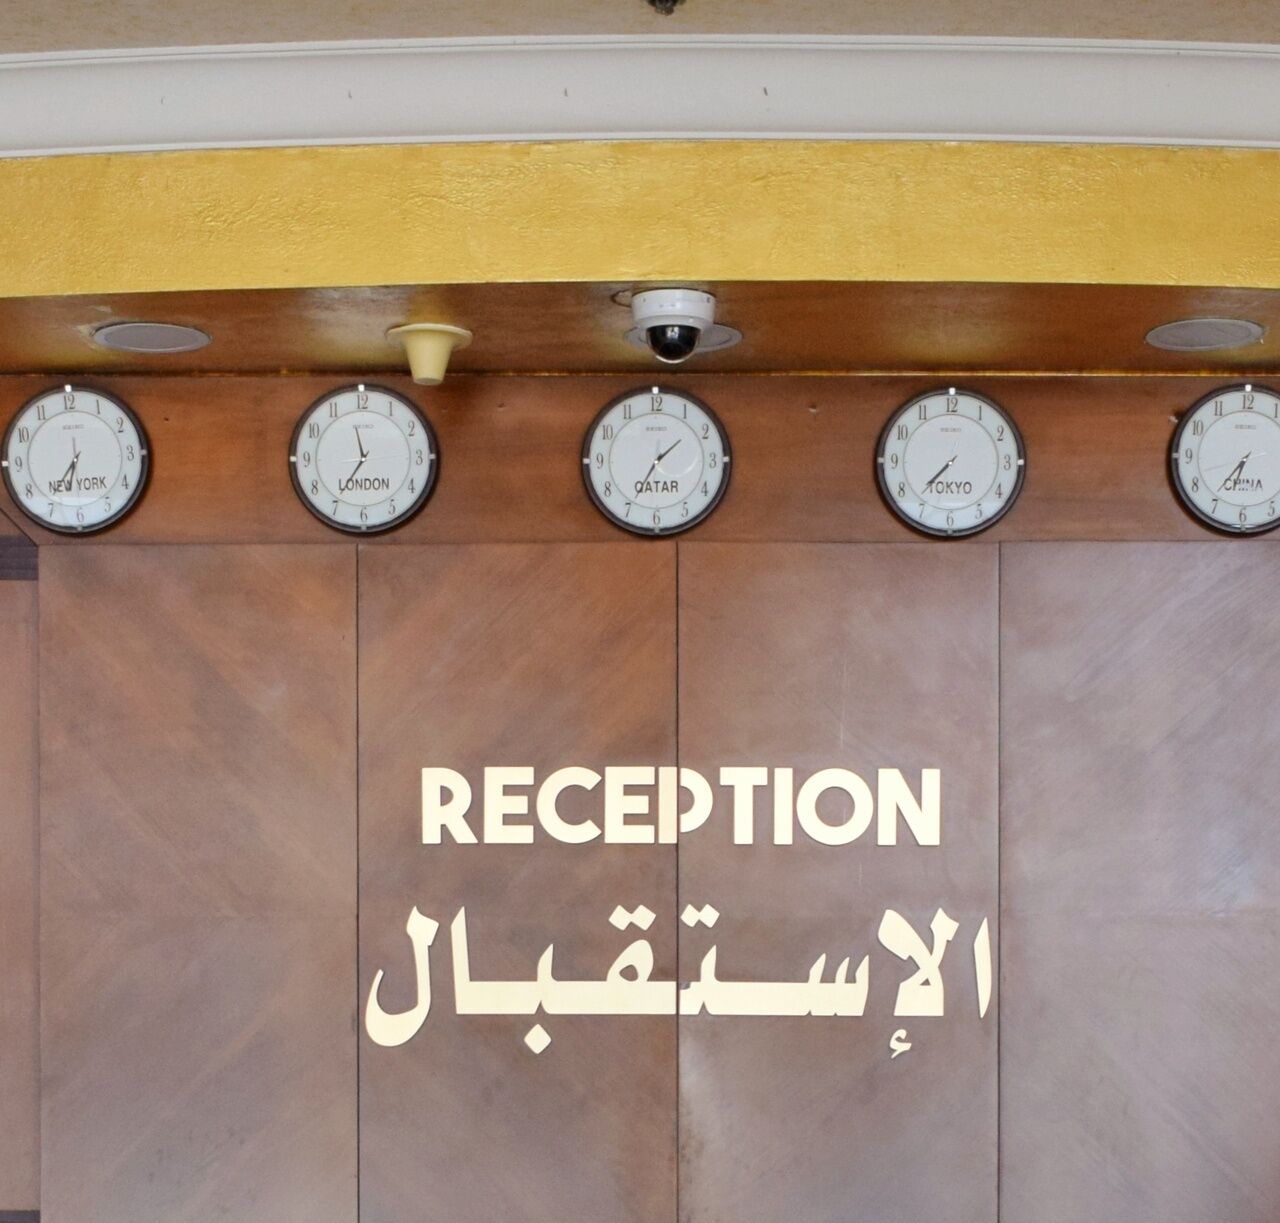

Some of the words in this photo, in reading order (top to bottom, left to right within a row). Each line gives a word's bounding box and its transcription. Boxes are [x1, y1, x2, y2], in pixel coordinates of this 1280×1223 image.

[64, 394, 75, 410] 12
[96, 399, 100, 414] 1
[356, 394, 368, 409] 12
[389, 401, 393, 416] 1
[650, 396, 663, 412] 12
[946, 397, 958, 412] 12
[1214, 401, 1222, 416] 11
[1242, 394, 1254, 410] 12
[37, 405, 46, 420] 11
[329, 402, 338, 418] 11
[623, 404, 631, 419] 11
[683, 404, 687, 419] 1
[919, 405, 926, 420] 11
[978, 405, 982, 421] 1
[1274, 403, 1278, 418] 1
[116, 417, 124, 432] 2
[309, 423, 319, 438] 10
[408, 421, 415, 436] 2
[602, 424, 613, 440] 10
[702, 424, 709, 439] 2
[1192, 420, 1204, 435] 10
[18, 427, 29, 443] 10
[897, 425, 908, 440] 10
[997, 425, 1004, 441] 2
[126, 445, 134, 461] 3
[303, 452, 310, 467] 9
[416, 449, 423, 465] 3
[709, 453, 717, 468] 3
[1185, 448, 1192, 464] 9
[15, 456, 22, 472] 9
[596, 454, 604, 469] 9
[891, 454, 898, 469] 9
[1004, 455, 1011, 470] 3
[49, 480, 72, 492] NEW
[76, 477, 107, 491] YORK
[122, 474, 129, 489] 4
[312, 480, 318, 495] 8
[338, 478, 389, 491] LONDON
[408, 478, 416, 493] 4
[635, 481, 678, 493] QATAR
[701, 481, 709, 496] 4
[928, 482, 972, 494] TOKYO
[1192, 477, 1199, 492] 8
[26, 484, 33, 499] 8
[604, 482, 611, 497] 8
[898, 482, 905, 497] 8
[995, 483, 1003, 499] 4
[48, 503, 54, 518] 7
[104, 497, 112, 512] 5
[331, 500, 338, 515] 7
[388, 499, 396, 515] 5
[624, 502, 631, 518] 7
[681, 502, 688, 518] 5
[919, 503, 925, 519] 7
[975, 504, 982, 519] 5
[1212, 499, 1218, 514] 7
[1268, 501, 1275, 516] 5
[77, 507, 84, 522] 6
[360, 507, 368, 522] 6
[653, 510, 660, 525] 6
[946, 511, 954, 526] 6
[1239, 506, 1246, 522] 6
[421, 766, 941, 846] RECEPTION
[365, 904, 992, 1059] الإستقبال
